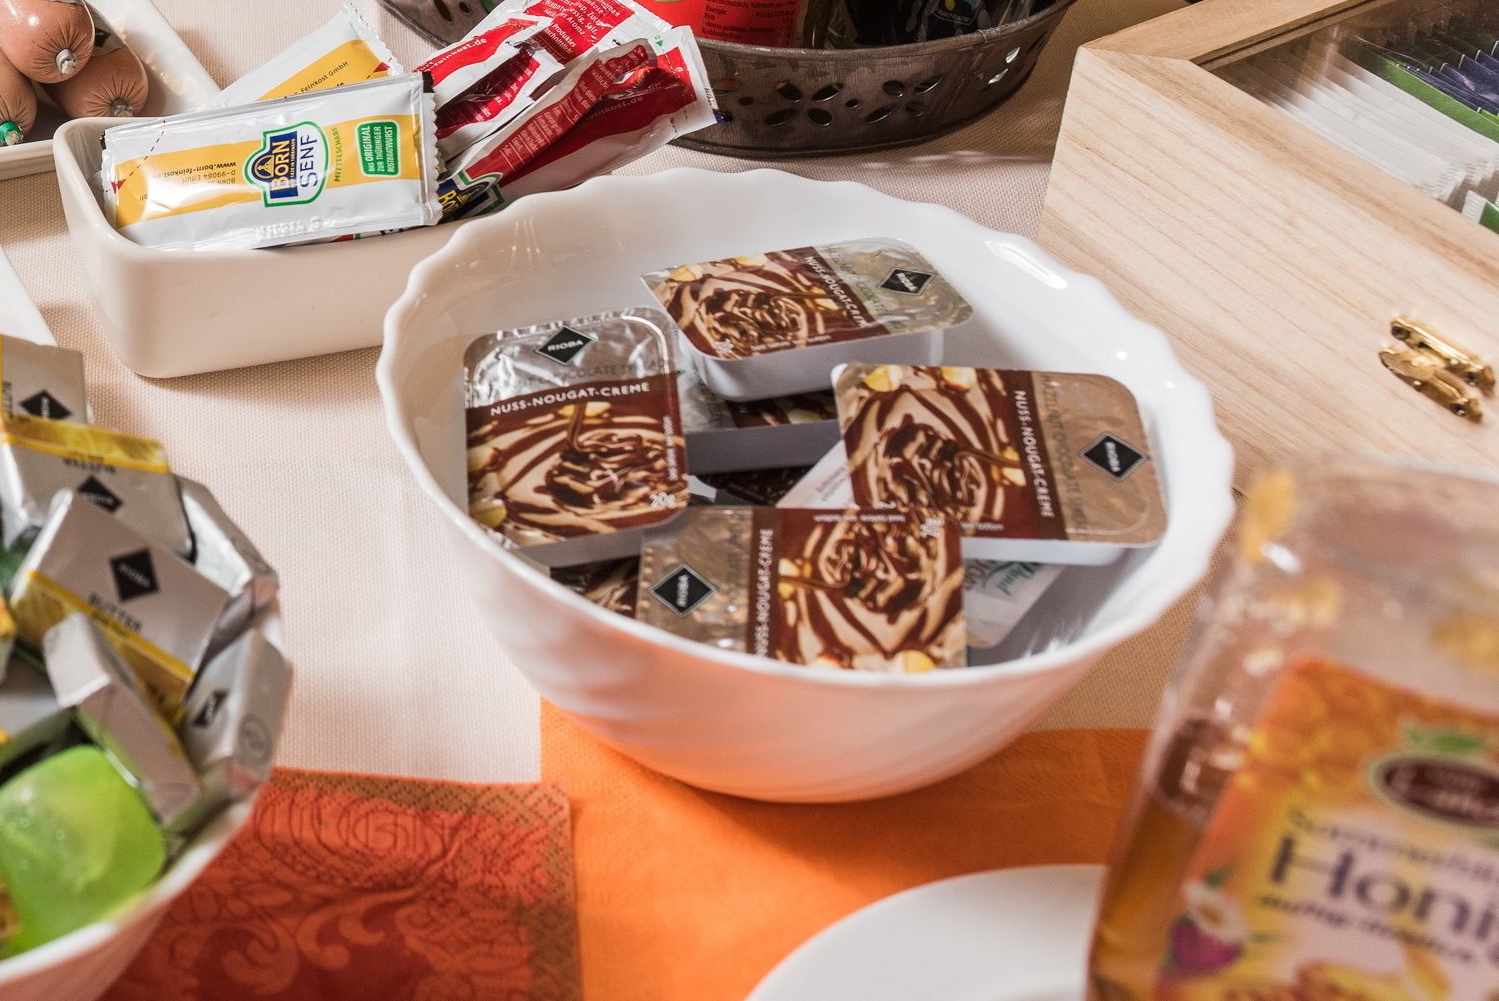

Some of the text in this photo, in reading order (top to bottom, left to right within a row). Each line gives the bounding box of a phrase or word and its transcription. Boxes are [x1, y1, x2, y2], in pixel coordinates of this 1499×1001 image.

[553, 23, 578, 48] Produktes
[300, 61, 350, 94] Feinkost GmbH
[300, 134, 319, 188] SENF
[331, 126, 343, 182] MITTELSCHARF
[361, 125, 375, 161] ORIGINAL
[373, 126, 385, 172] ZUR THÜRINGER
[384, 126, 396, 173] ROSTBRATWURST
[202, 169, 236, 182] D-99084
[271, 139, 291, 191] BORN
[547, 339, 584, 353] RIOBA
[490, 381, 651, 417] NUSS-NOUGAT-CREME
[1014, 389, 1056, 519] NUSS-NOUGAT-CREME
[1104, 440, 1122, 473] RIOBA
[88, 593, 143, 633] BUTTER
[1267, 829, 1499, 968] Honi
